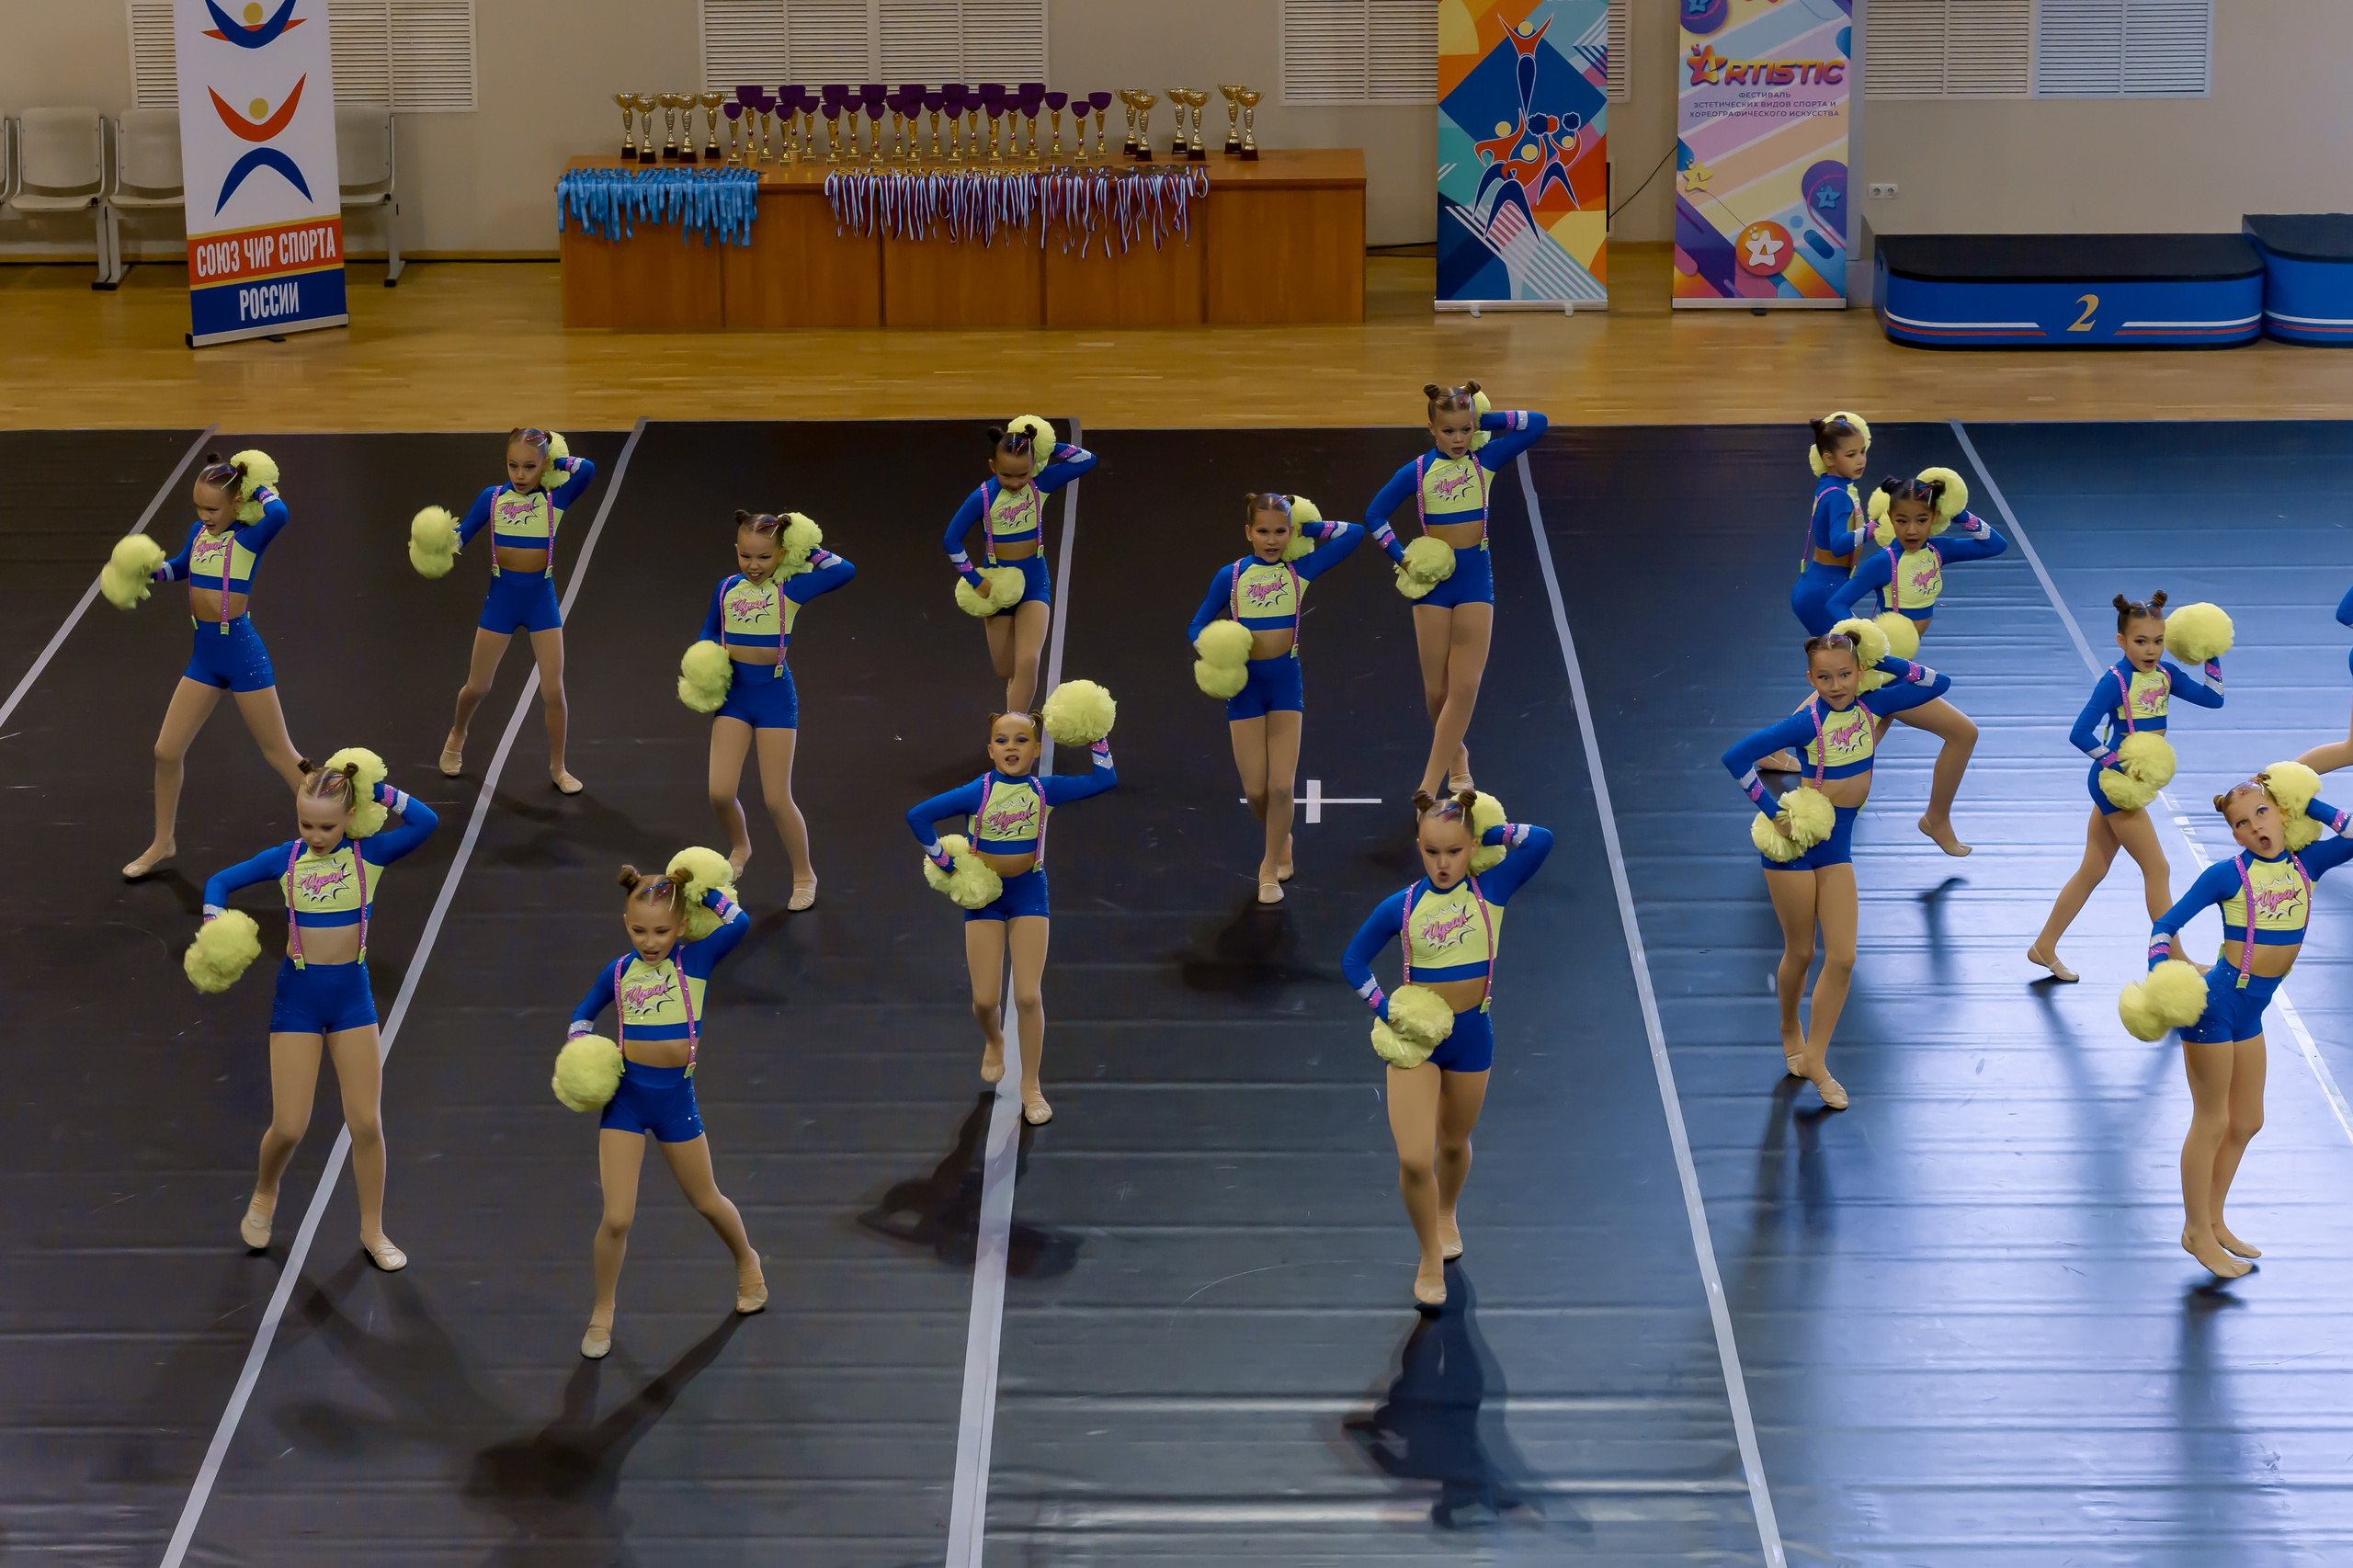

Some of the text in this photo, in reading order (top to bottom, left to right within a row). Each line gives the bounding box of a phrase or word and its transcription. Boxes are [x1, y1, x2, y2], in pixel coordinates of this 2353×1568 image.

[1687, 44, 1845, 85] ARTISTIC
[197, 227, 336, 278] СОЮЗ ЧИР СПОРТА
[239, 281, 300, 322] РОССИИ
[2066, 293, 2099, 332] 2
